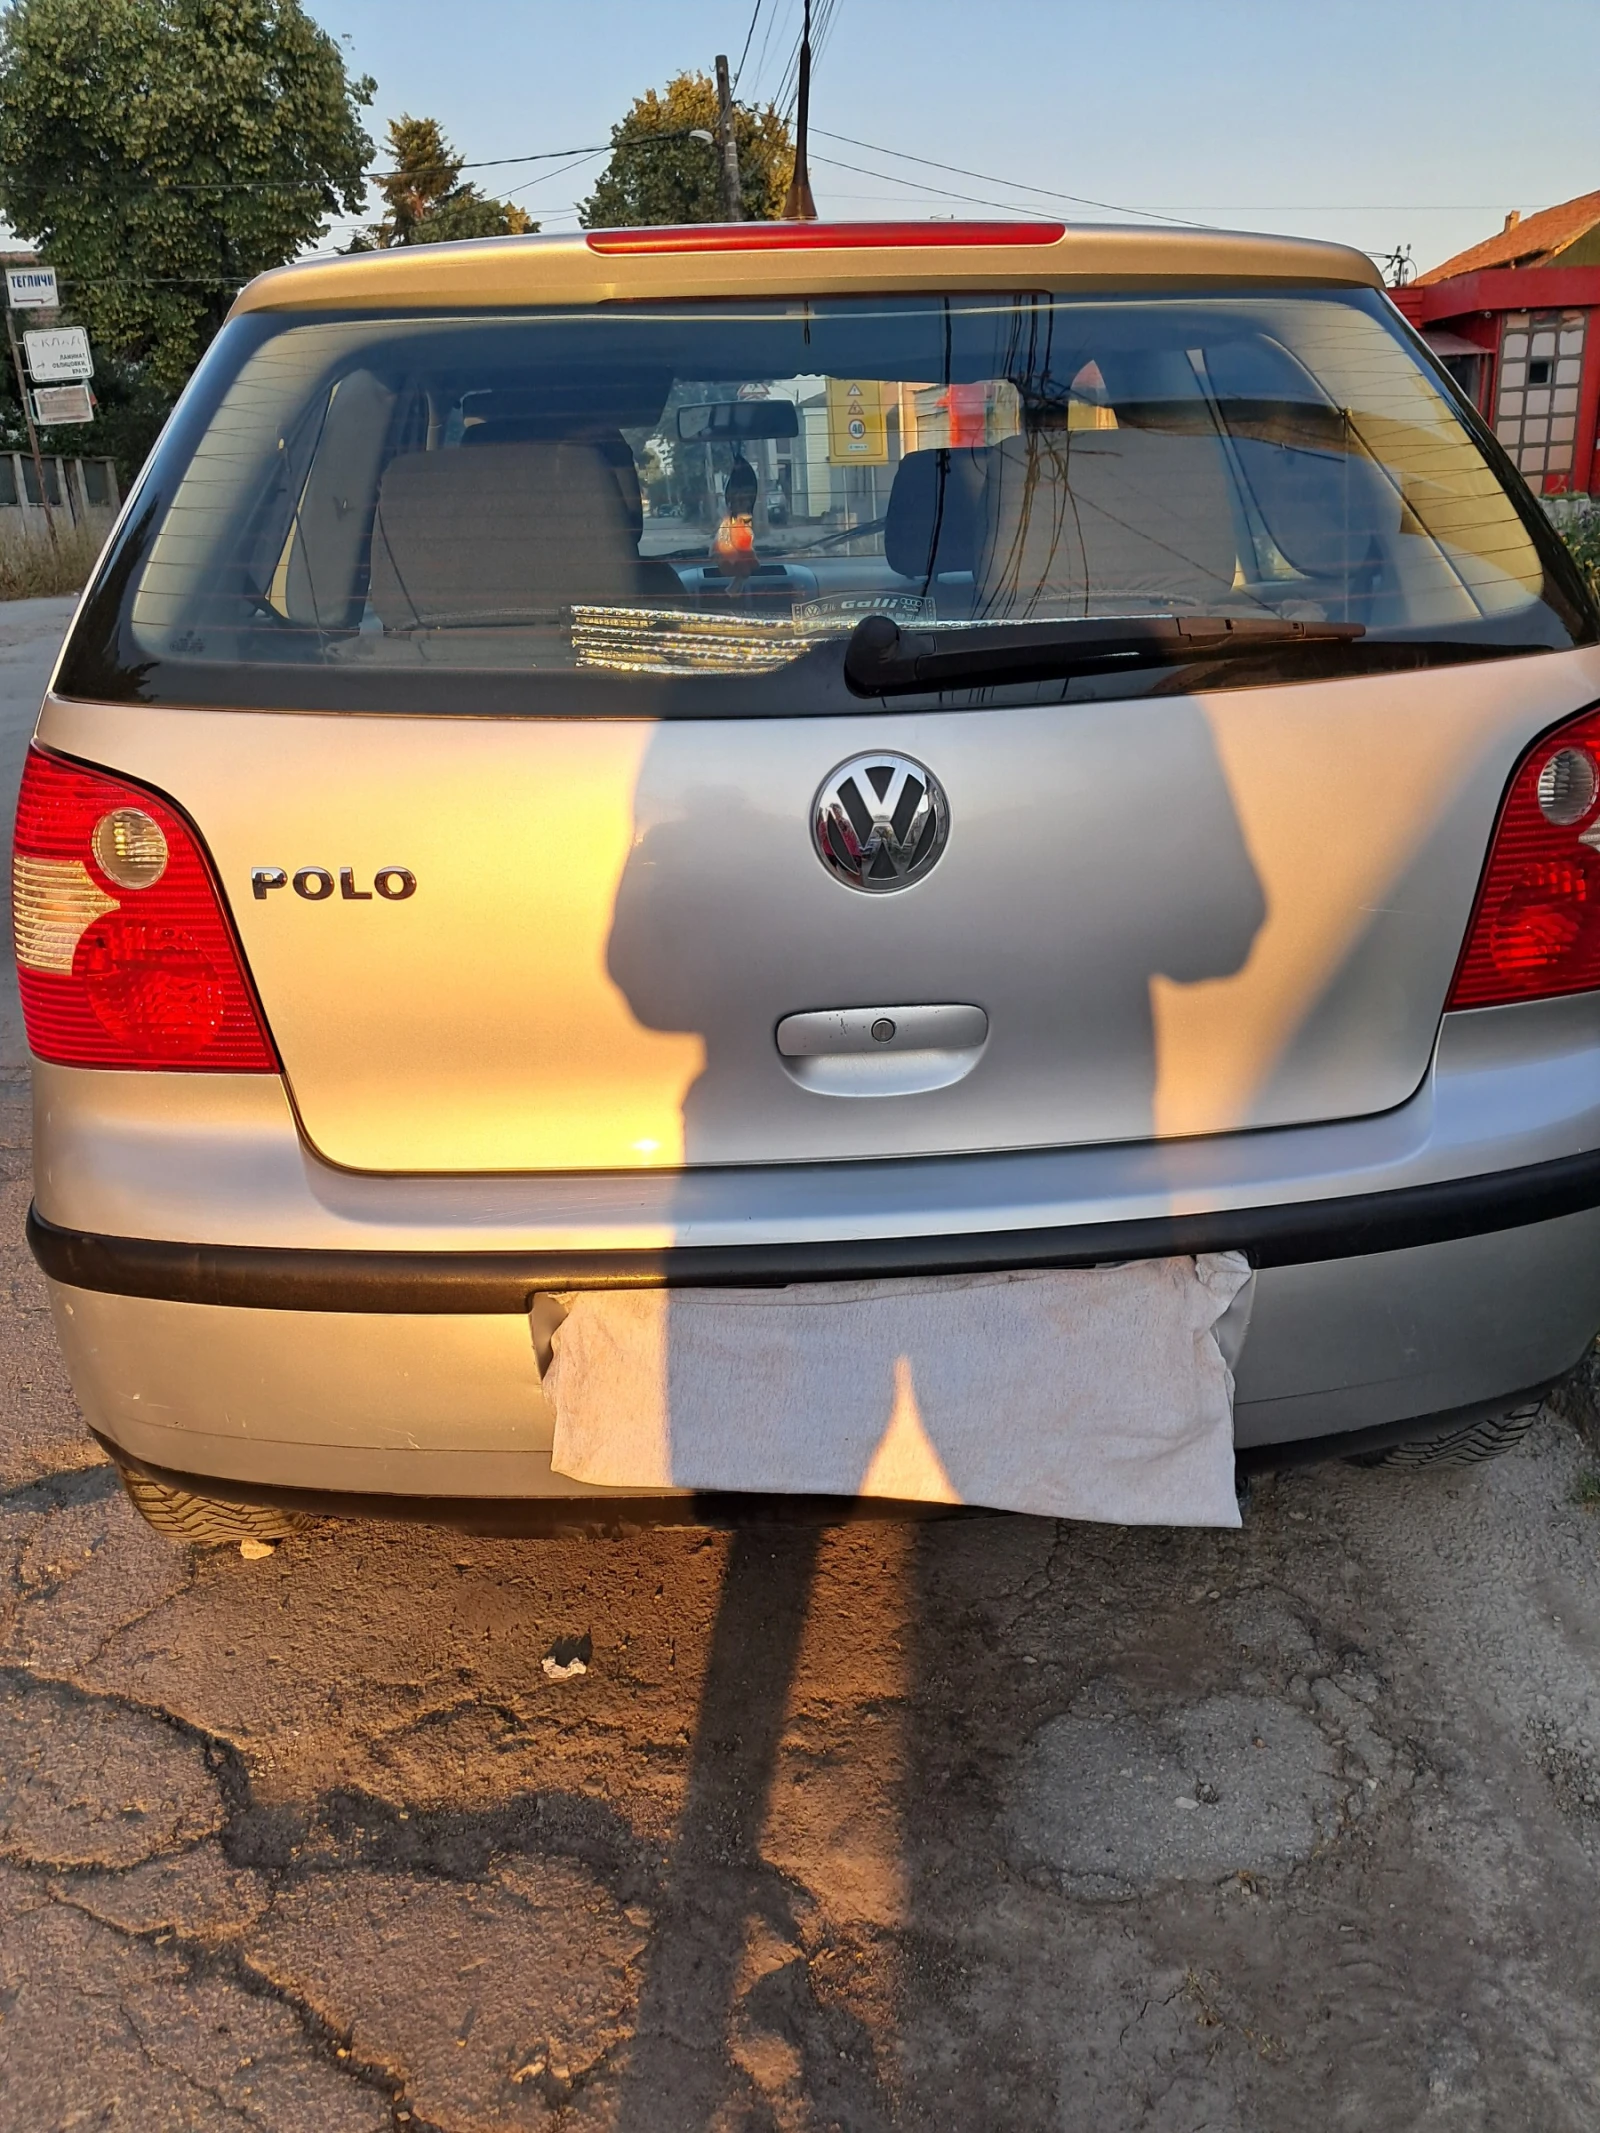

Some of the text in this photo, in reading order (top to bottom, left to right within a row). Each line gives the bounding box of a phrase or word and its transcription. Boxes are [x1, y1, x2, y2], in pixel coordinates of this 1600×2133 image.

[10, 274, 54, 288] ТЕГЛИЧИ
[852, 423, 863, 434] 40
[841, 598, 899, 609] Galli
[251, 865, 418, 901] POLO
